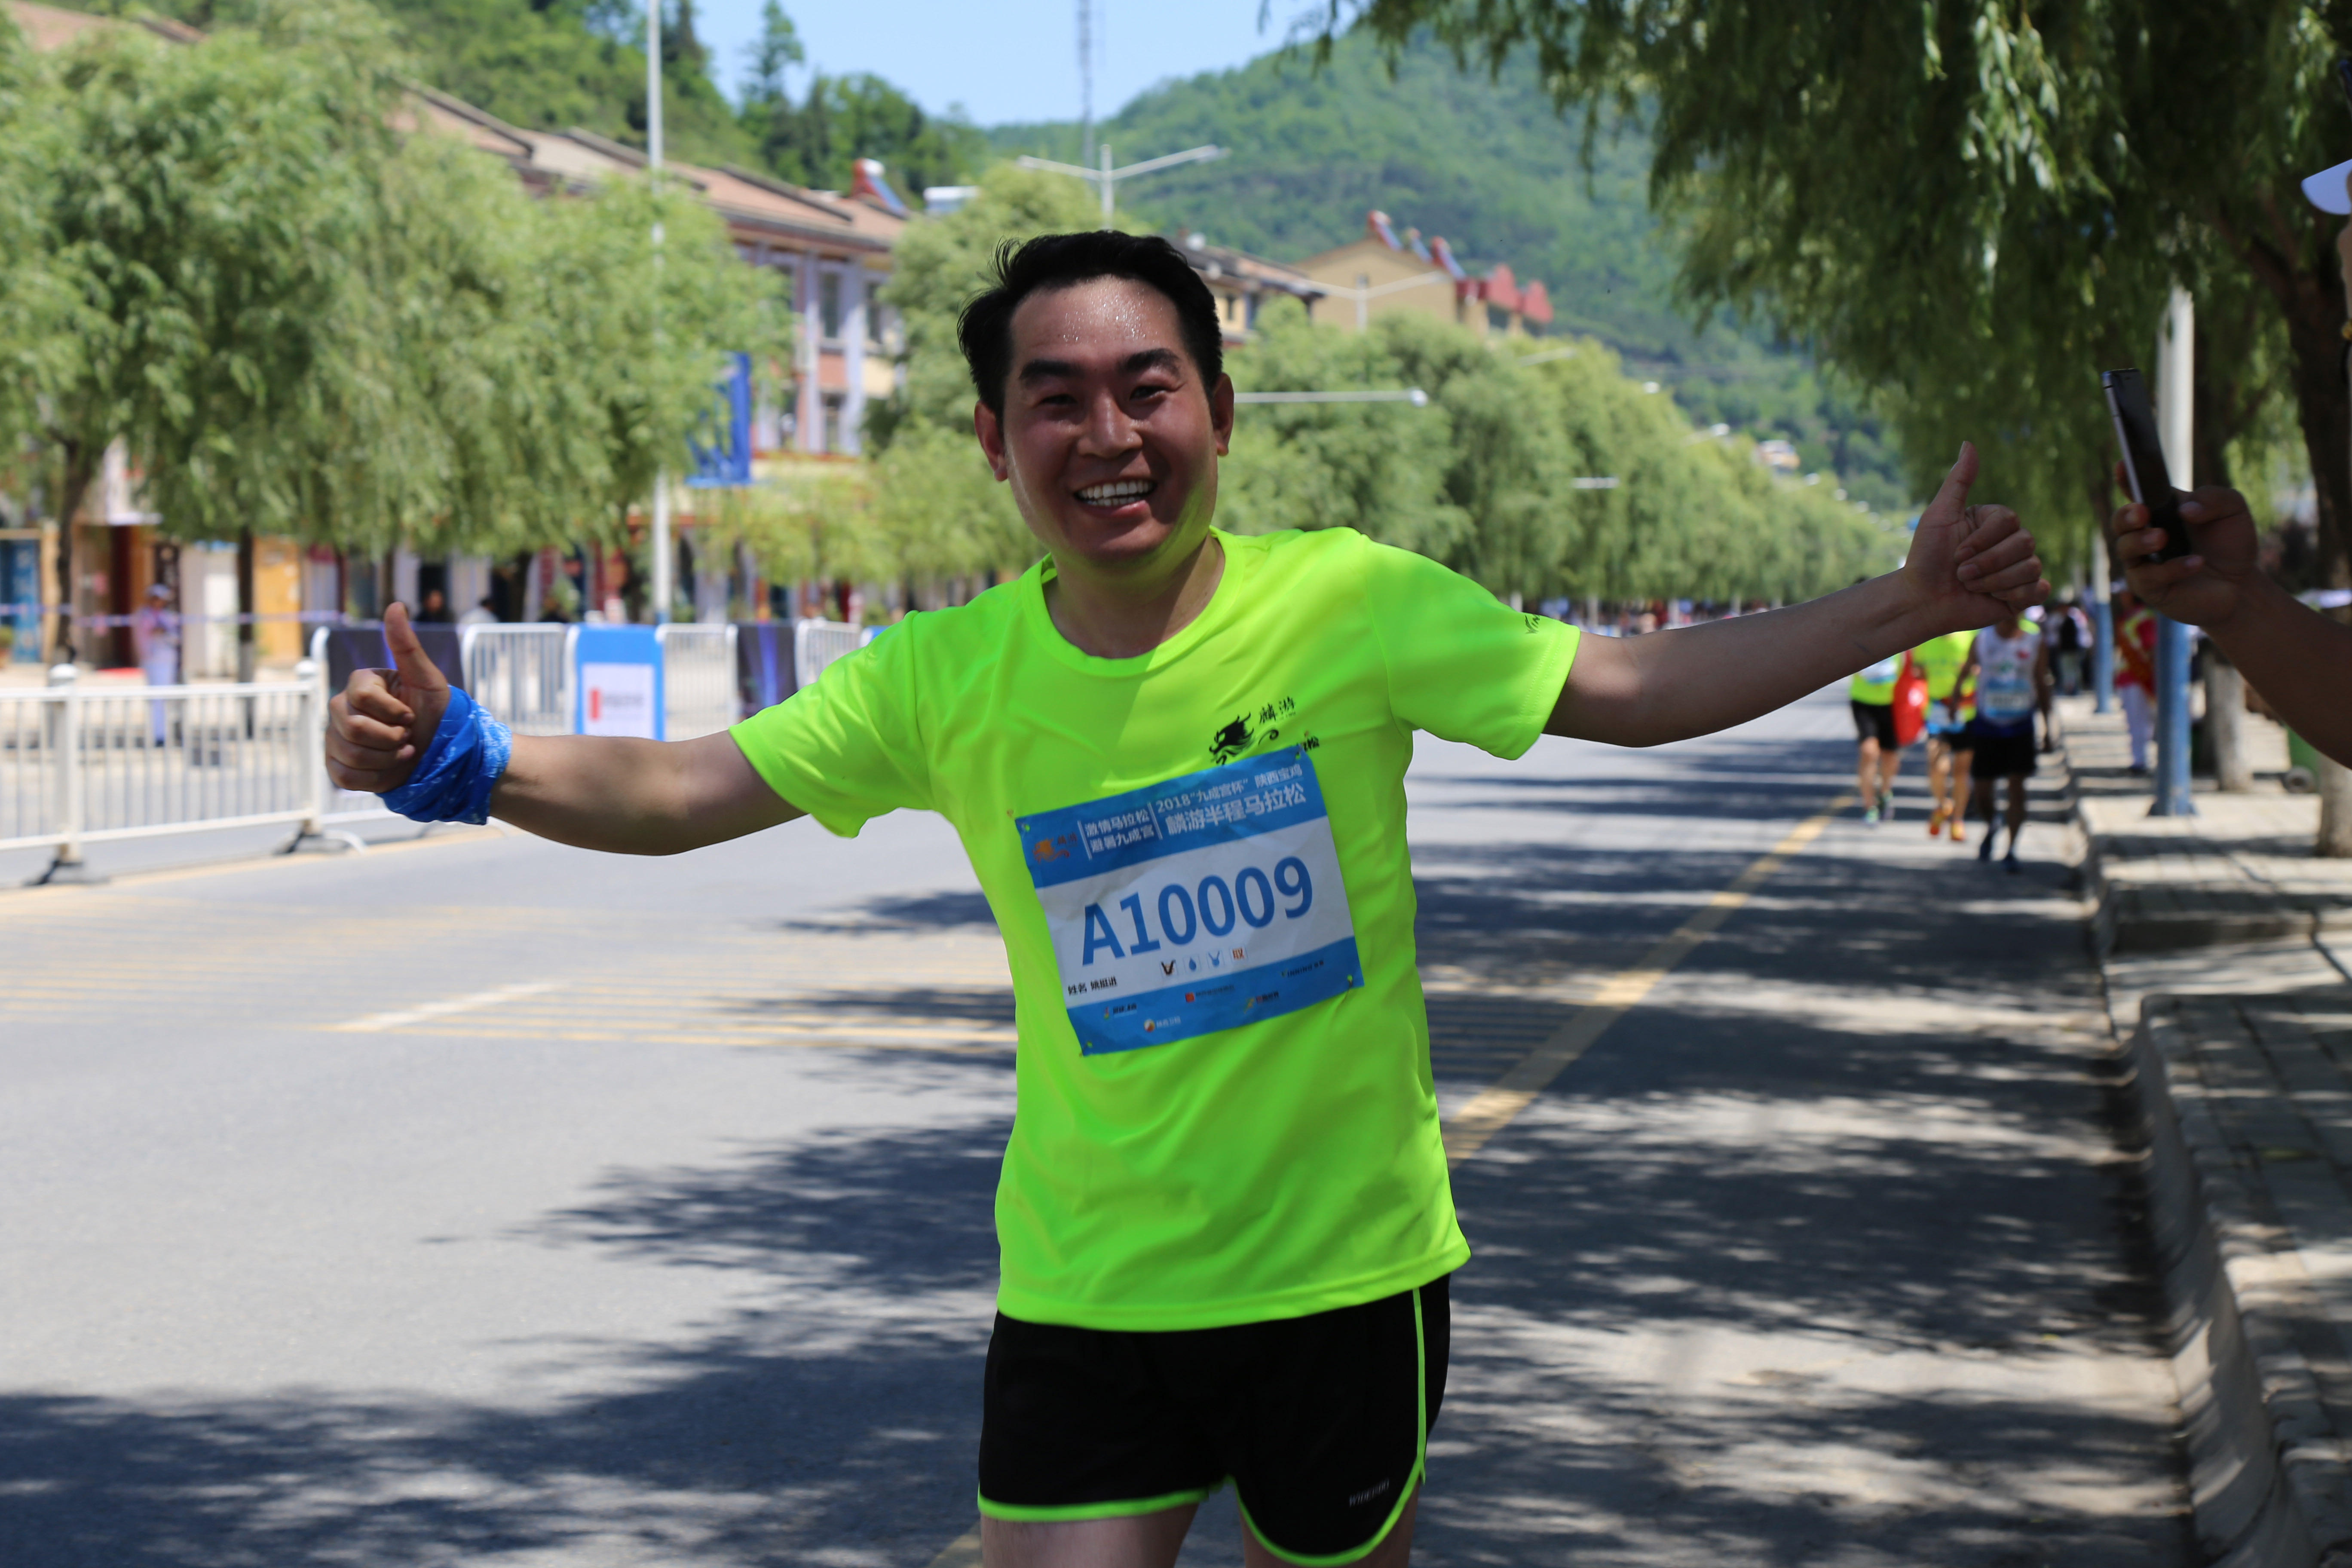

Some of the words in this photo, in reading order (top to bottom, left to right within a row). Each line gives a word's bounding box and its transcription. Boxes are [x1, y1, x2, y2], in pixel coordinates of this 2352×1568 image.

[1254, 763, 1303, 788] 陕西宝鸡
[1084, 808, 1150, 837] 激情马拉松
[1165, 782, 1307, 836] 麟游半程马拉松
[1090, 824, 1155, 853] 避暑九成宫
[1082, 855, 1313, 966] A10009
[1232, 947, 1245, 961] 取
[1068, 982, 1087, 996] 姓名
